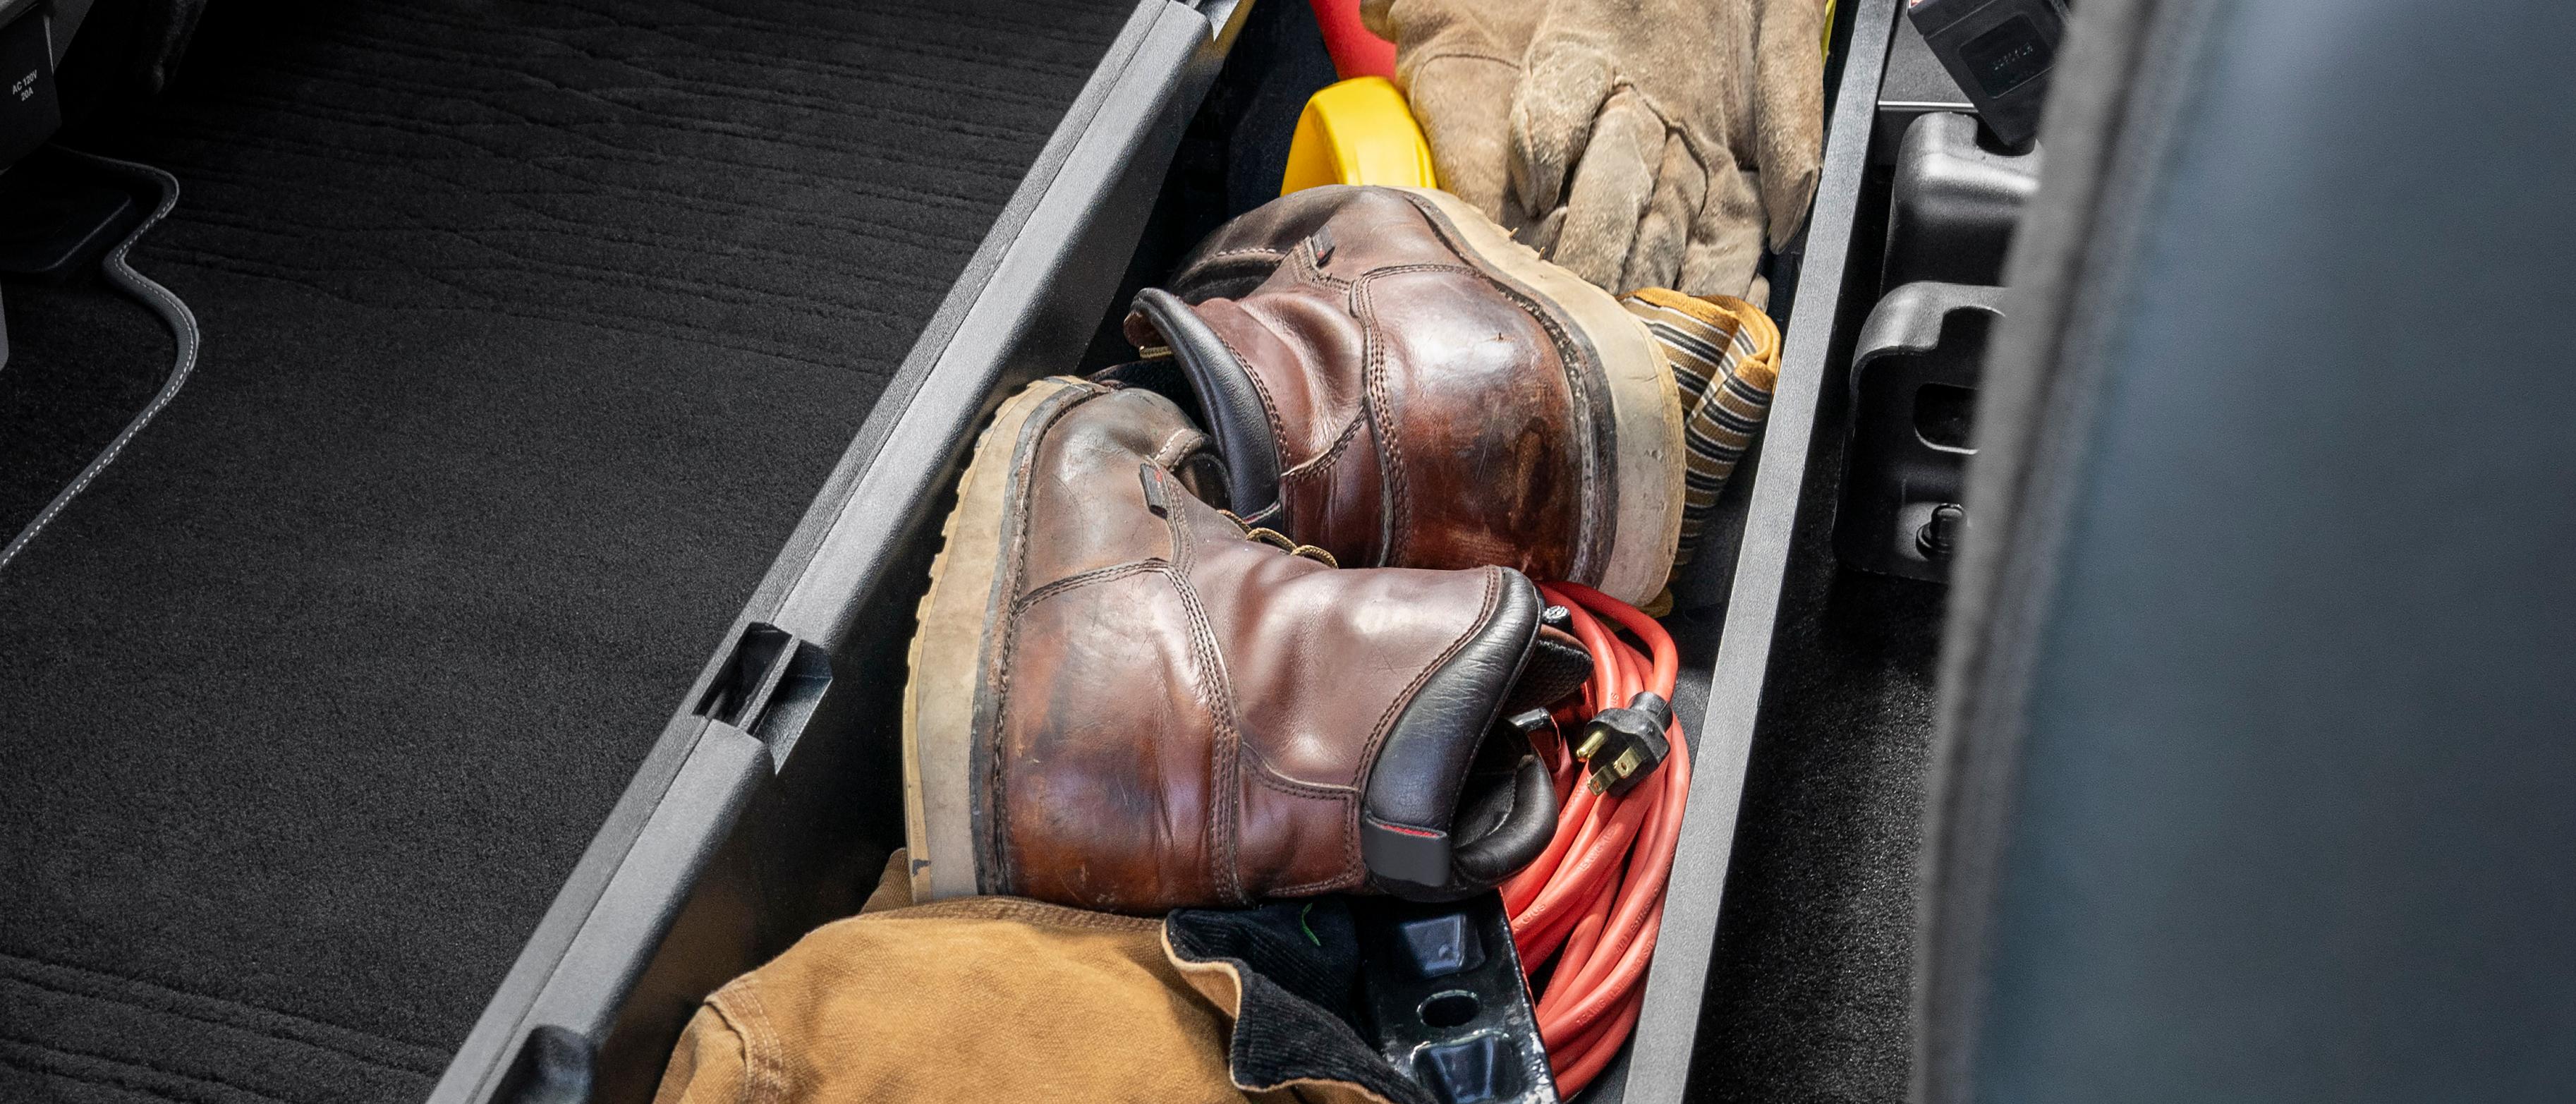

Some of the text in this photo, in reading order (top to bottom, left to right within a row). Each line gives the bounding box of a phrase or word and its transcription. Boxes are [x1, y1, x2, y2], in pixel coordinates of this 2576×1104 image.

[12, 69, 37, 95] AC 120V
[20, 87, 34, 102] 20A
